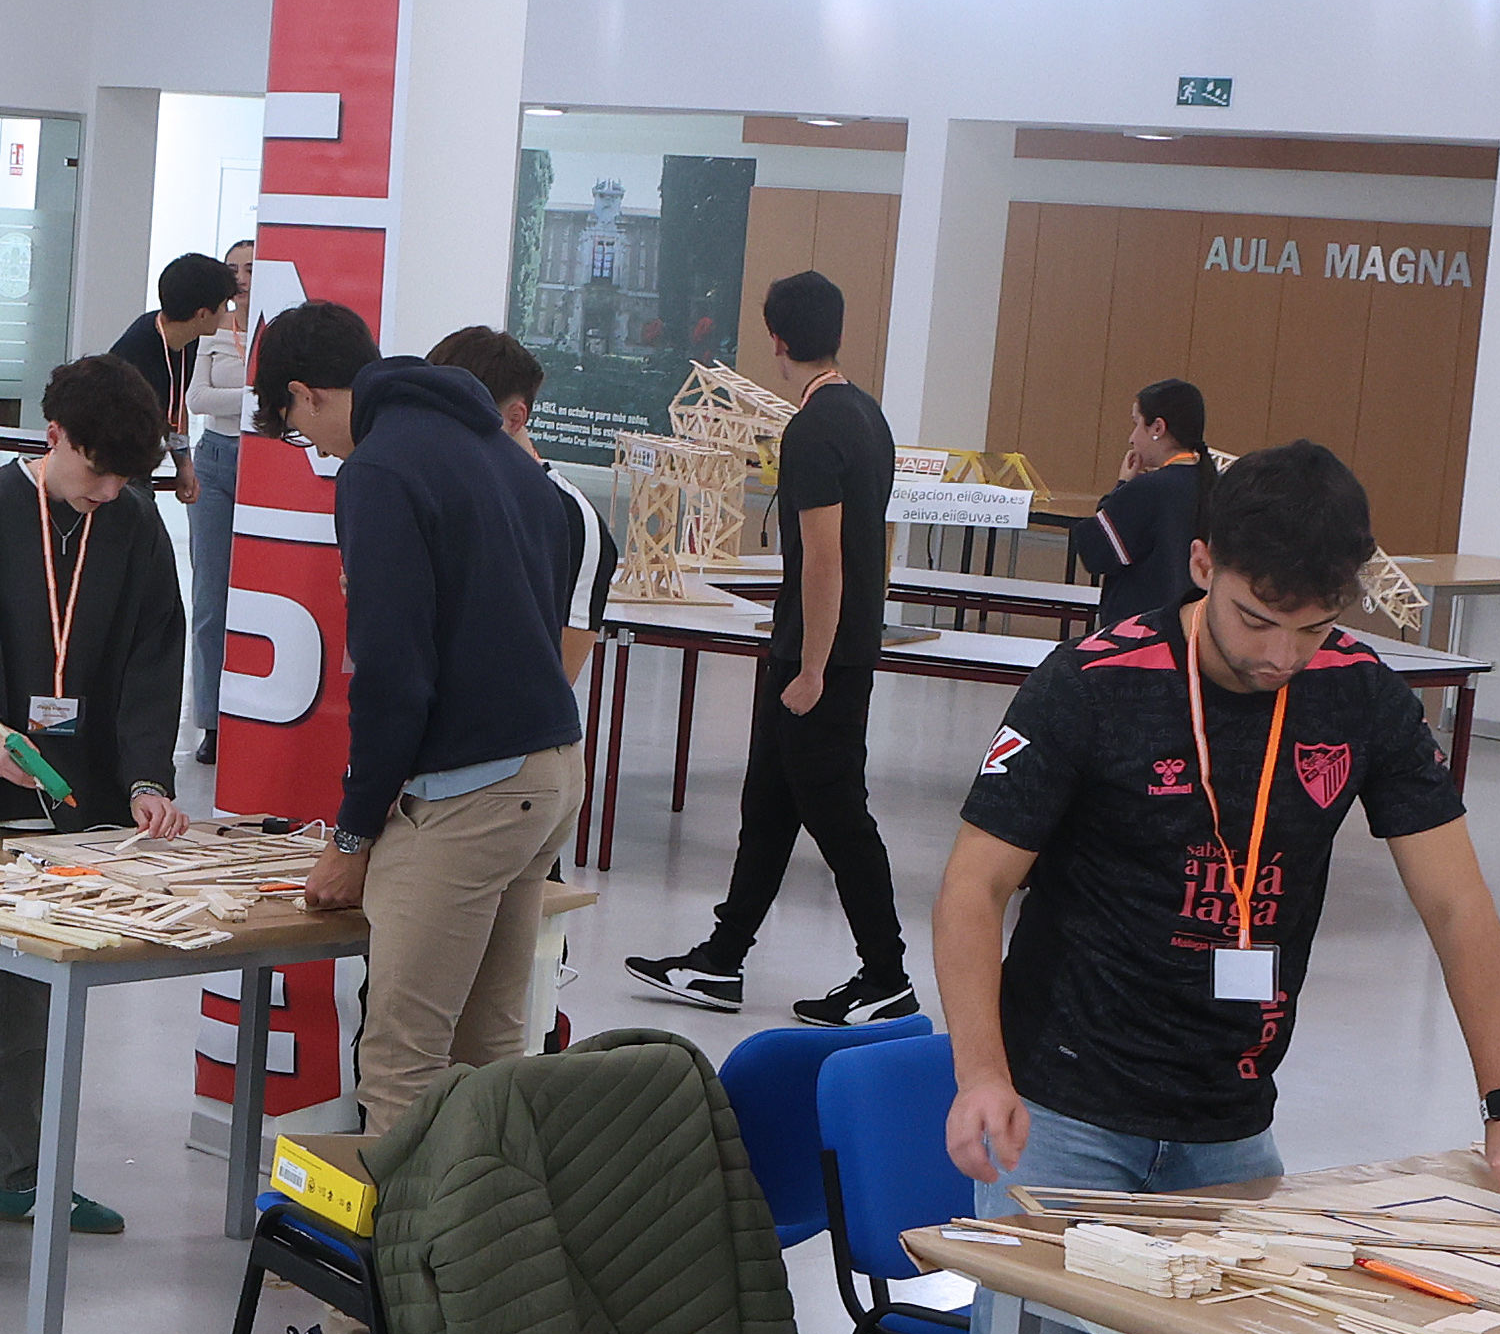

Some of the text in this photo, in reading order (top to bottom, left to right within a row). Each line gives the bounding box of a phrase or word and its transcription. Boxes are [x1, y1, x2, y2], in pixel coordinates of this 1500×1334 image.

[1204, 235, 1473, 288] AULA MAGNA
[1148, 782, 1193, 796] hummel
[1184, 857, 1201, 876] a
